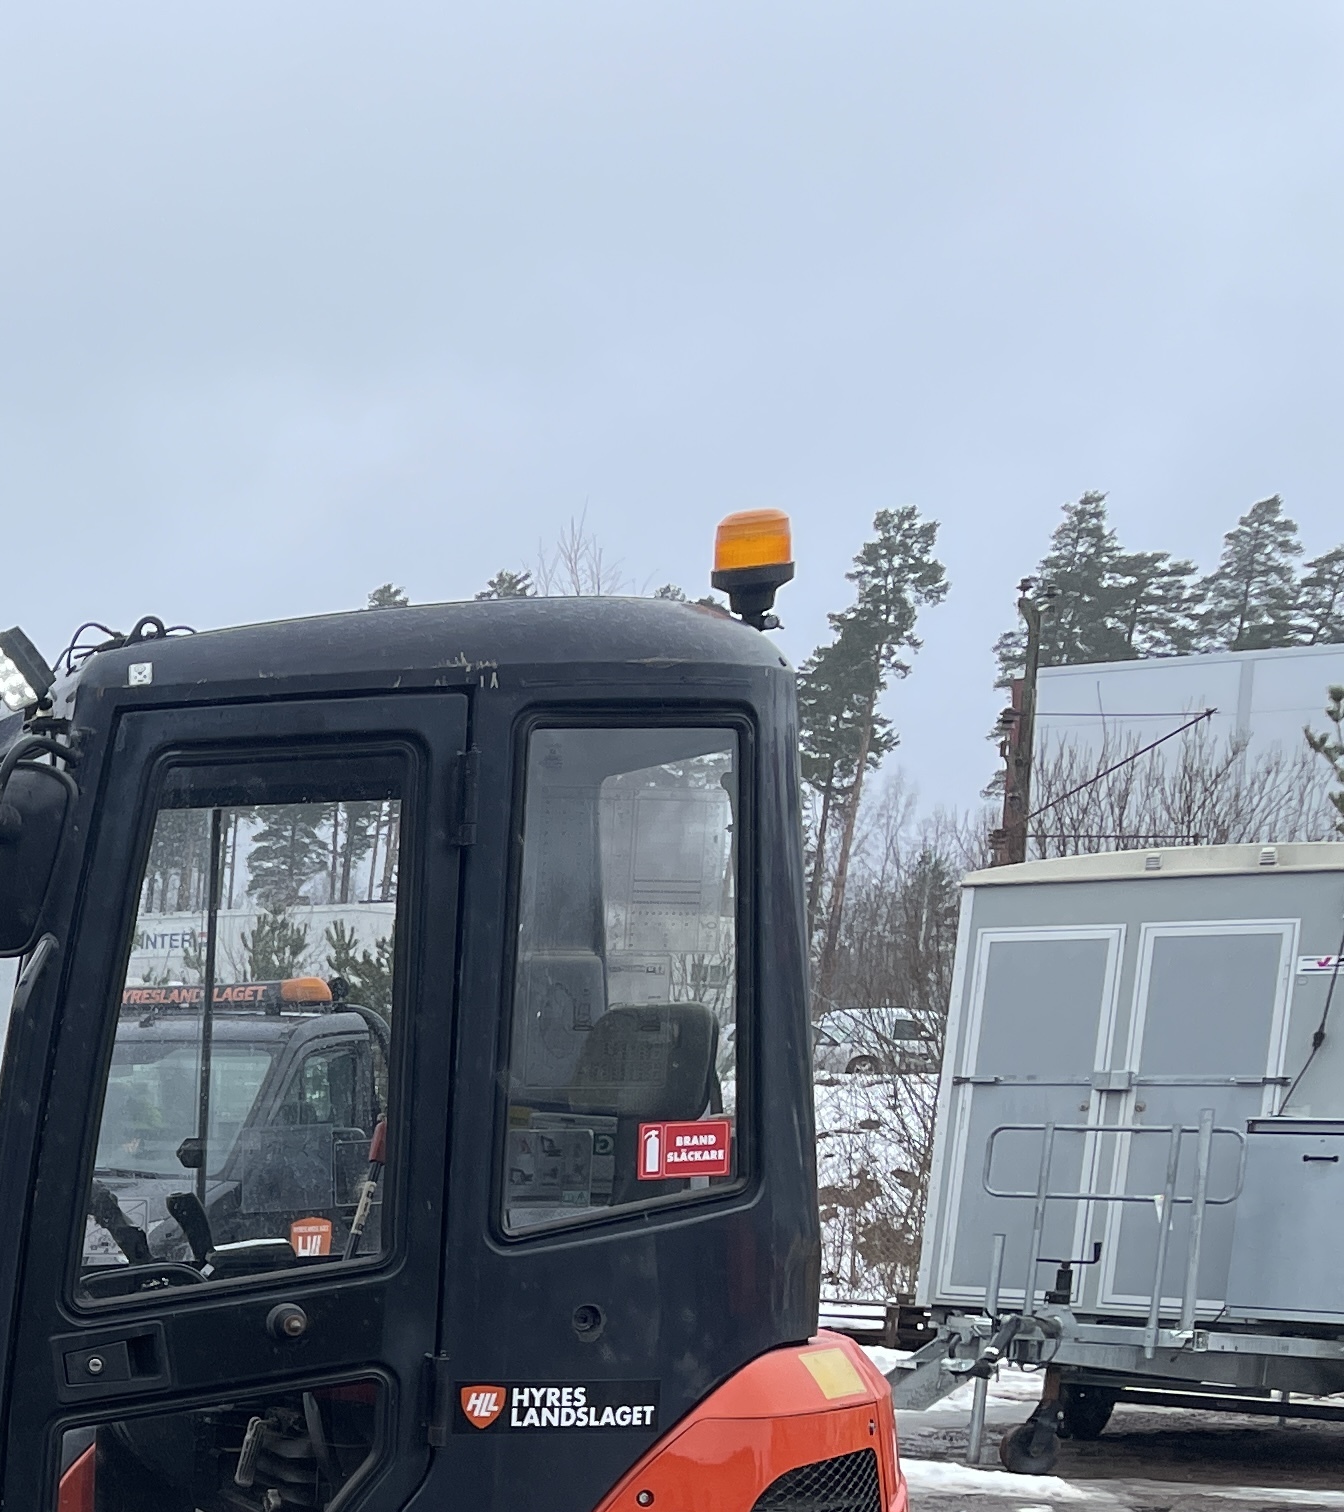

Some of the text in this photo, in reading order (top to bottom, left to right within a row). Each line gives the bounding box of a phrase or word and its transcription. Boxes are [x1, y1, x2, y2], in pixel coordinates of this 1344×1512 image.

[676, 1135, 716, 1146] BRAND
[667, 1149, 724, 1162] SLÄCKARE
[467, 1392, 499, 1417] HLL
[512, 1387, 587, 1407] HYRES
[511, 1406, 655, 1427] LANDSLAGET
